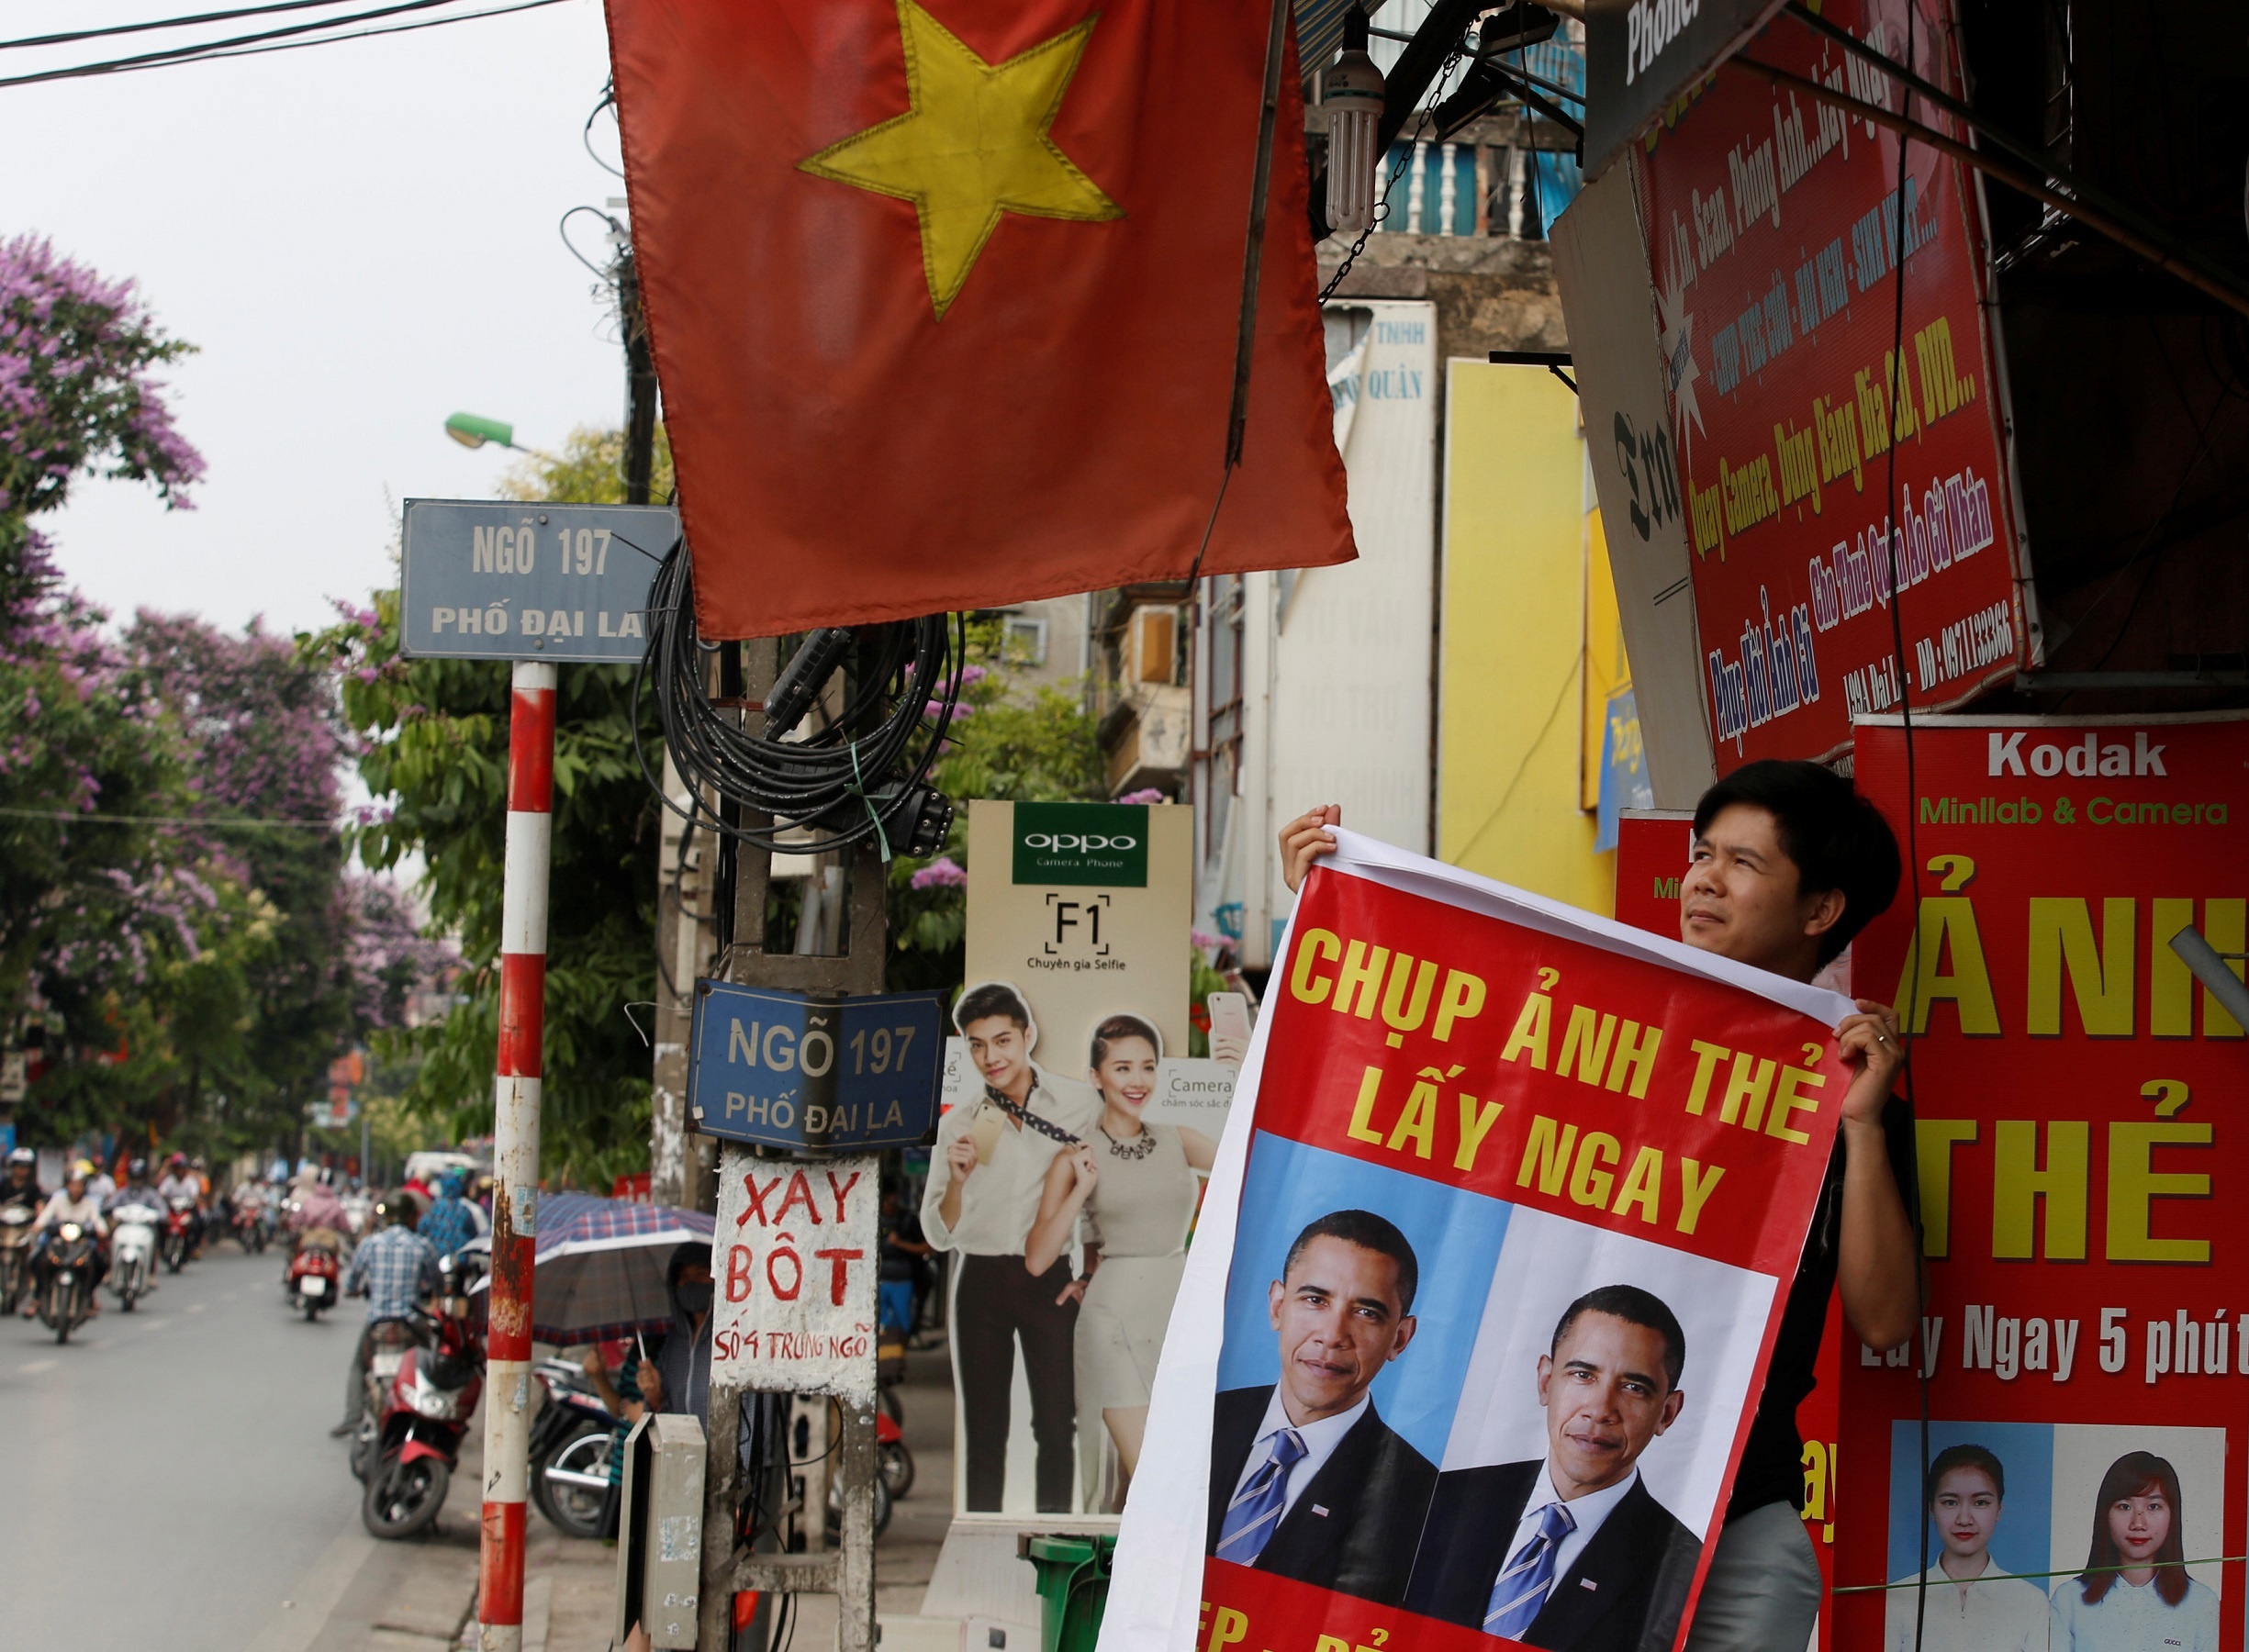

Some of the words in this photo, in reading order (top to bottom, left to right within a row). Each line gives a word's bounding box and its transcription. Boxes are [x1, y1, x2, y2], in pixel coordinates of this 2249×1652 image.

[1692, 187, 1735, 270] Scan,
[1728, 134, 1780, 229] Phóng
[1795, 245, 1820, 347] HỘI
[1816, 236, 1851, 323] NGHỊ
[1852, 206, 1886, 294] SINH
[1376, 322, 1425, 344] TNHH
[1688, 478, 1725, 564] Quay
[1719, 453, 1781, 537] Camera,
[1773, 418, 1821, 522] Dựng
[1813, 393, 1863, 493] Băng
[1914, 316, 1975, 426] DVD...
[472, 518, 535, 576] NGÕ
[558, 529, 612, 576] 197
[1809, 555, 1839, 632] Cho
[1833, 531, 1873, 620] Thuê
[1903, 483, 1930, 586] Áo
[1924, 476, 1952, 574] Cử
[1945, 466, 1994, 563] Nhân
[431, 598, 509, 635] PHỐ
[520, 608, 585, 643] ĐẠI
[597, 610, 643, 639] LA
[1709, 648, 1748, 758] Phục
[1740, 619, 1772, 729] Hồi
[1761, 585, 1799, 718] Ảnh
[1791, 603, 1820, 706] Cũ
[1988, 731, 2167, 776] Kodak
[2053, 797, 2076, 824] &
[2087, 797, 2228, 824] Camera
[1024, 833, 1136, 854] oppo
[1036, 857, 1080, 867] Camera
[1087, 858, 1124, 867] Phone
[1057, 902, 1099, 944] F1
[1891, 854, 2247, 1036] ẢNH
[1027, 957, 1070, 970] Chuyên
[1074, 959, 1091, 971] gia
[1094, 959, 1125, 970] Selfie
[727, 1015, 834, 1078] NGÕ
[849, 1026, 916, 1076] 197
[1290, 927, 1487, 1049] CHỤP
[1501, 966, 1662, 1100] ẢNH
[1684, 1043, 1827, 1145] THẺ
[1171, 1077, 1232, 1092] Camera
[724, 1088, 798, 1130] PHỐ
[804, 1103, 857, 1141] ĐẠI
[1347, 1064, 1505, 1172] LẤY
[1516, 1115, 1726, 1236] NGAY
[736, 1168, 861, 1227] XAY
[725, 1232, 864, 1307] BÔT
[829, 1323, 872, 1360] NGÕ
[1963, 1305, 2079, 1382] Ngay
[2098, 1307, 2127, 1373] 5
[2145, 1309, 2249, 1384] phút
